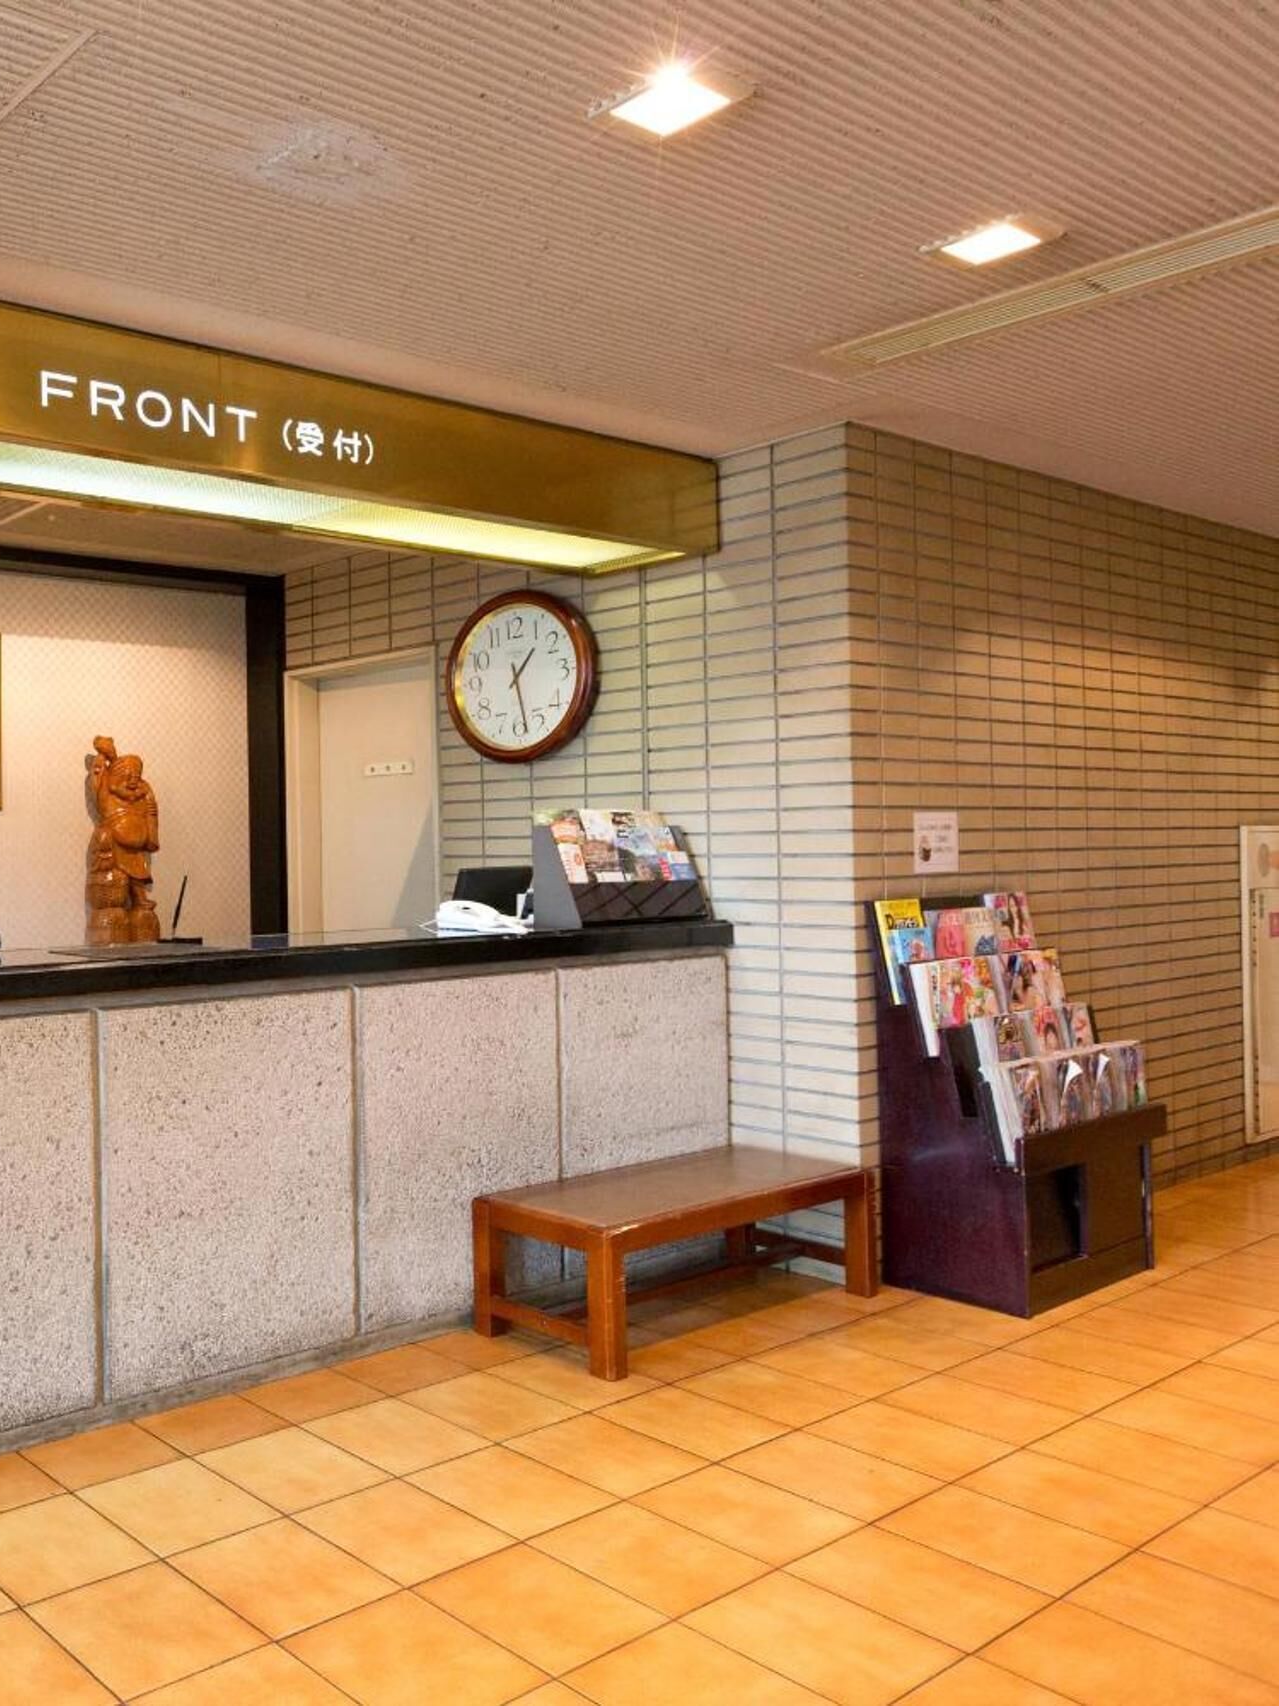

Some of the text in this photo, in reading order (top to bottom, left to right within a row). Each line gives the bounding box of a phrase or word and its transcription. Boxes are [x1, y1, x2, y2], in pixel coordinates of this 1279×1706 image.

[39, 369, 258, 443] FRONT
[489, 628, 500, 648] 11
[506, 616, 523, 640] 12
[546, 631, 560, 654] 2
[472, 652, 490, 673] 10
[557, 658, 571, 681] 3
[477, 697, 492, 720] 8
[549, 688, 561, 709] 4
